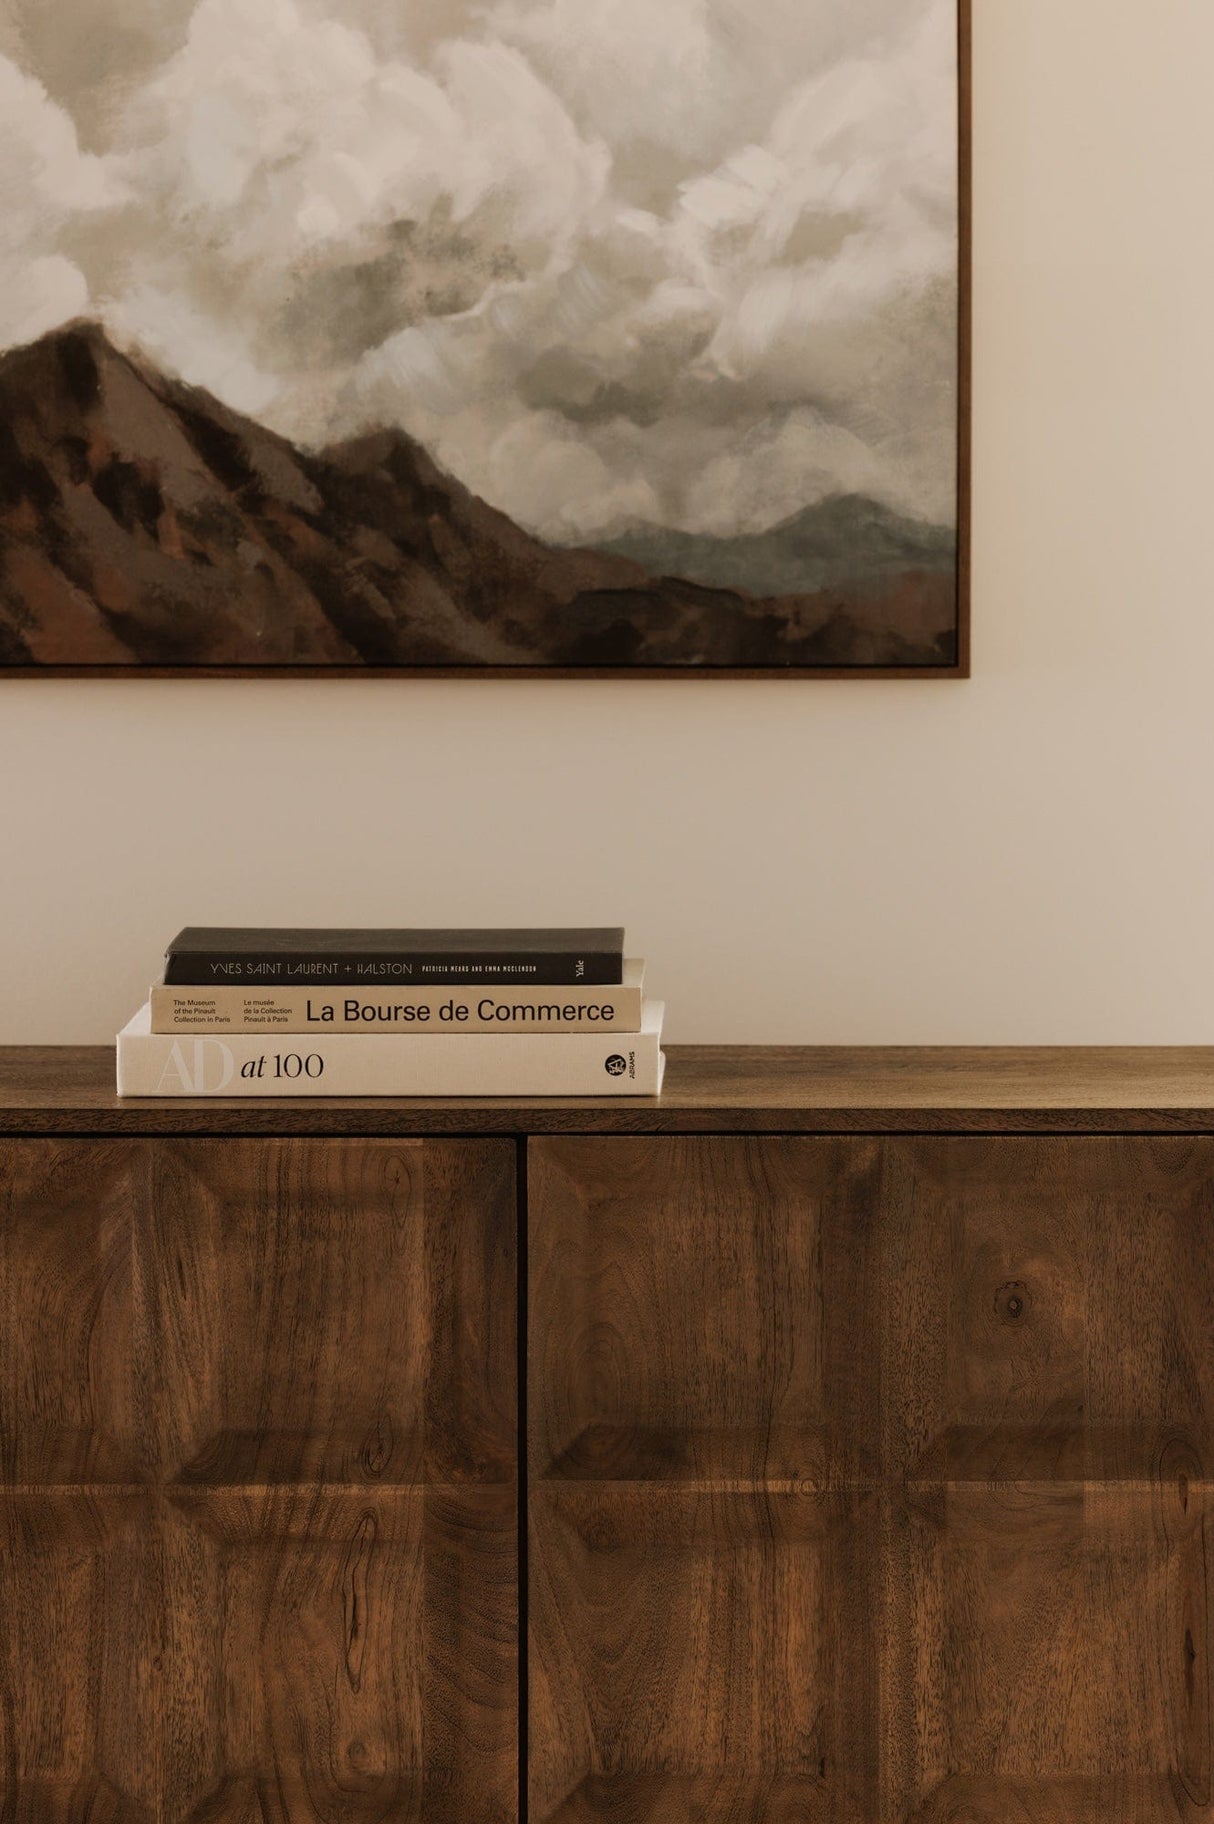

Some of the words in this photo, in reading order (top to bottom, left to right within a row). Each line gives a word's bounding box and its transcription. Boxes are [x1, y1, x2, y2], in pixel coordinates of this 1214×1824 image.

[210, 963, 242, 975] YVES
[246, 963, 282, 975] SAINT
[287, 963, 339, 975] LAURENT
[344, 965, 352, 973] +
[357, 963, 413, 975] HALSTON
[422, 965, 448, 973] PATRICIA
[450, 965, 469, 973] MEARS
[471, 965, 483, 973] AND
[485, 965, 500, 973] EMMA
[575, 959, 585, 978] Yale
[306, 1000, 334, 1022] La
[344, 1000, 431, 1022] Bourse
[438, 999, 469, 1022] de
[477, 999, 615, 1022] Commerce
[151, 1038, 235, 1093] AD
[240, 1054, 267, 1078] at
[273, 1053, 324, 1078] 100
